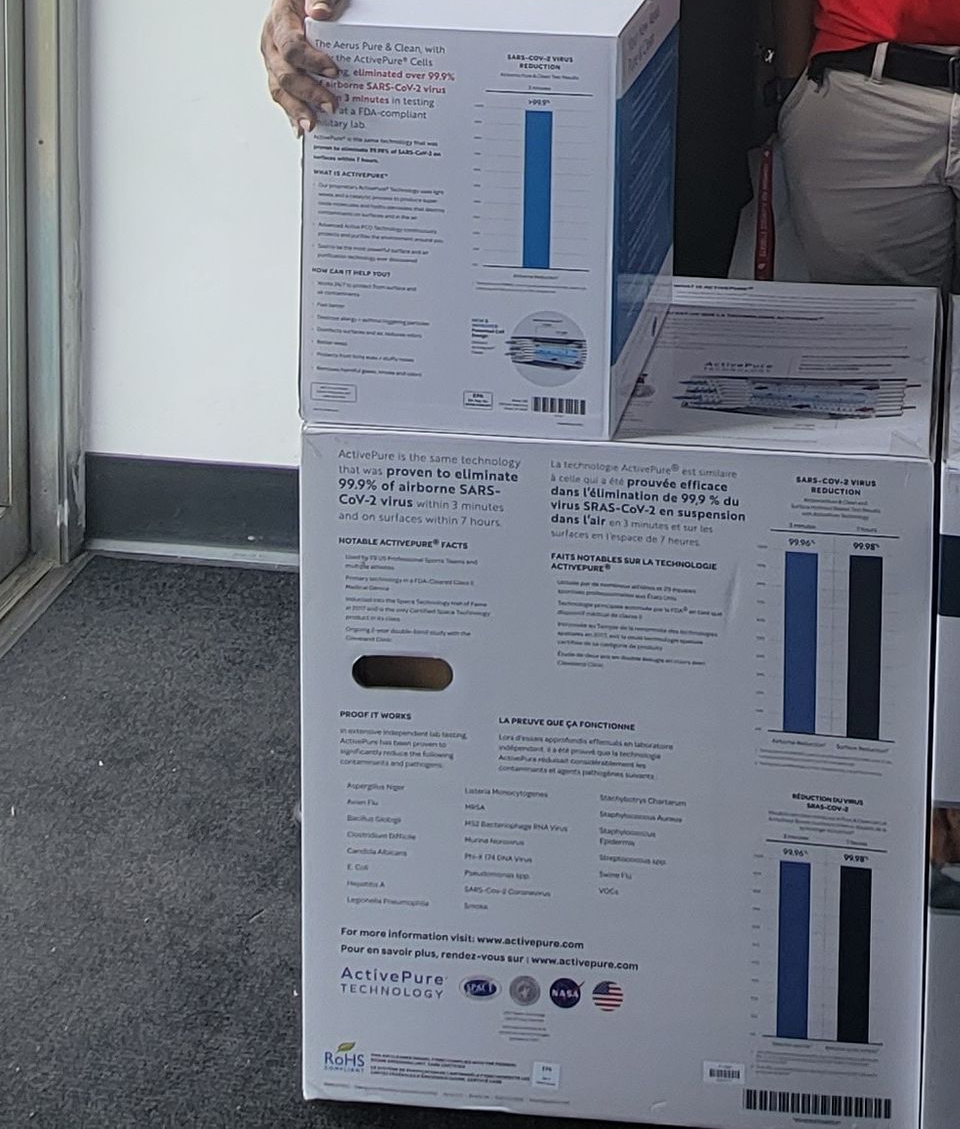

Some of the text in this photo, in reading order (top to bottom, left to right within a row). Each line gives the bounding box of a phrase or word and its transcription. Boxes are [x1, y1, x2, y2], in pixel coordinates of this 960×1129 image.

[315, 39, 445, 54] The Aerus Pure & Clean, with
[507, 54, 551, 63] SARS-COV-2
[353, 69, 402, 79] eliminated
[428, 72, 455, 81] 99.9%
[366, 83, 446, 94] SARS-CoV-2 virus
[344, 94, 350, 102] 3
[352, 95, 389, 104] minutes
[403, 97, 435, 108] testing
[338, 449, 521, 470] ActivePure is the same technology
[386, 466, 518, 482] proven to eliminate
[339, 478, 500, 496] 99.9% of airborne SARS-
[627, 478, 728, 492] prouvée efficace
[339, 494, 413, 508] CoV-2 virus
[551, 486, 580, 497] dans
[583, 488, 659, 502] l'élimination
[663, 492, 678, 503] de
[709, 495, 720, 506] %
[723, 496, 739, 507] du
[340, 711, 369, 719] PROOF
[381, 712, 411, 720] WORKS
[341, 927, 585, 950] For more information visit: www.activepure.com
[341, 983, 444, 1000] TECHNOLOGY
[551, 988, 579, 999] NASA
[325, 1051, 365, 1067] RoHS
